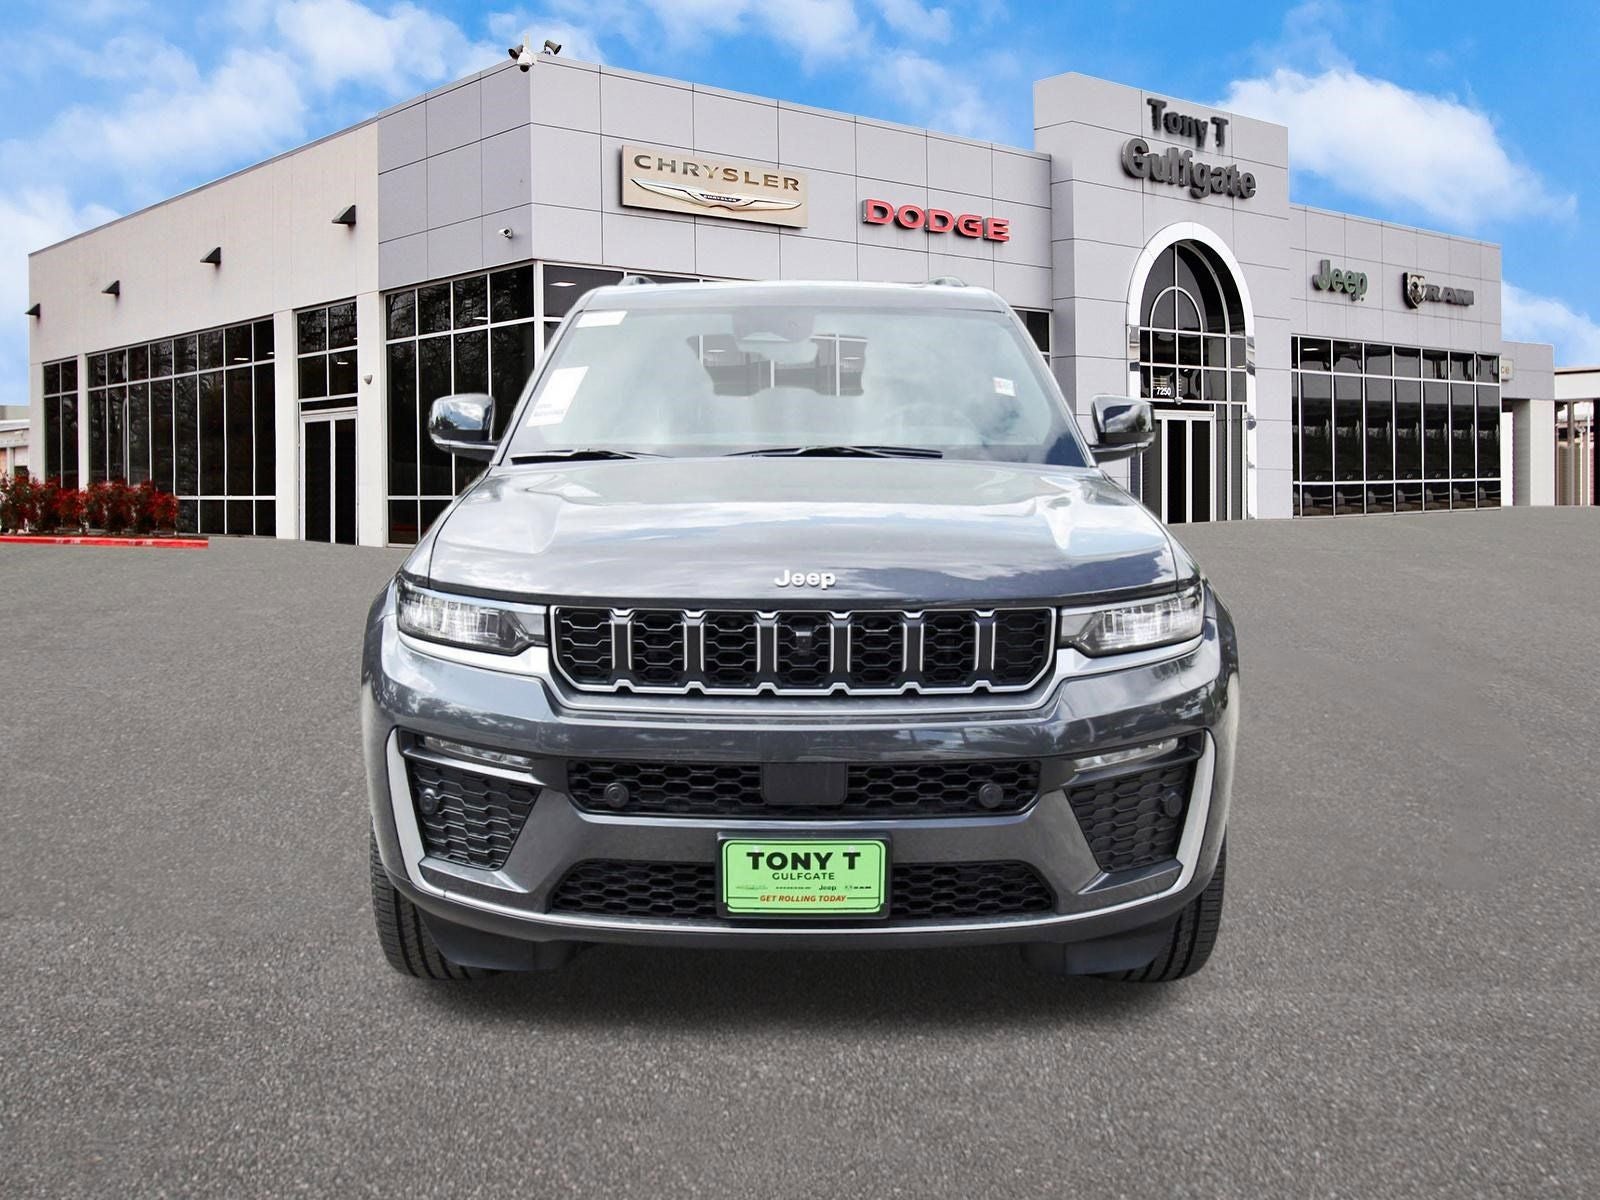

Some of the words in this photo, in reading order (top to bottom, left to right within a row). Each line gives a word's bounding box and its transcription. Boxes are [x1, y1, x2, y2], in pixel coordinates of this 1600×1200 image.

[1147, 98, 1208, 148] Tony
[1210, 116, 1229, 147] T
[633, 154, 801, 192] CHRYSLER
[1121, 138, 1257, 198] Gulfgate
[863, 198, 1010, 242] DODGE
[1313, 259, 1368, 301] Jeep
[1425, 283, 1475, 306] RAM
[1156, 386, 1172, 396] 7250
[774, 569, 836, 590] Jeep
[746, 852, 833, 870] TONY
[843, 852, 861, 870] T
[772, 872, 835, 880] GULFGATE
[760, 895, 776, 903] GET
[779, 895, 816, 903] ROLLING
[819, 895, 846, 903] TODAY
